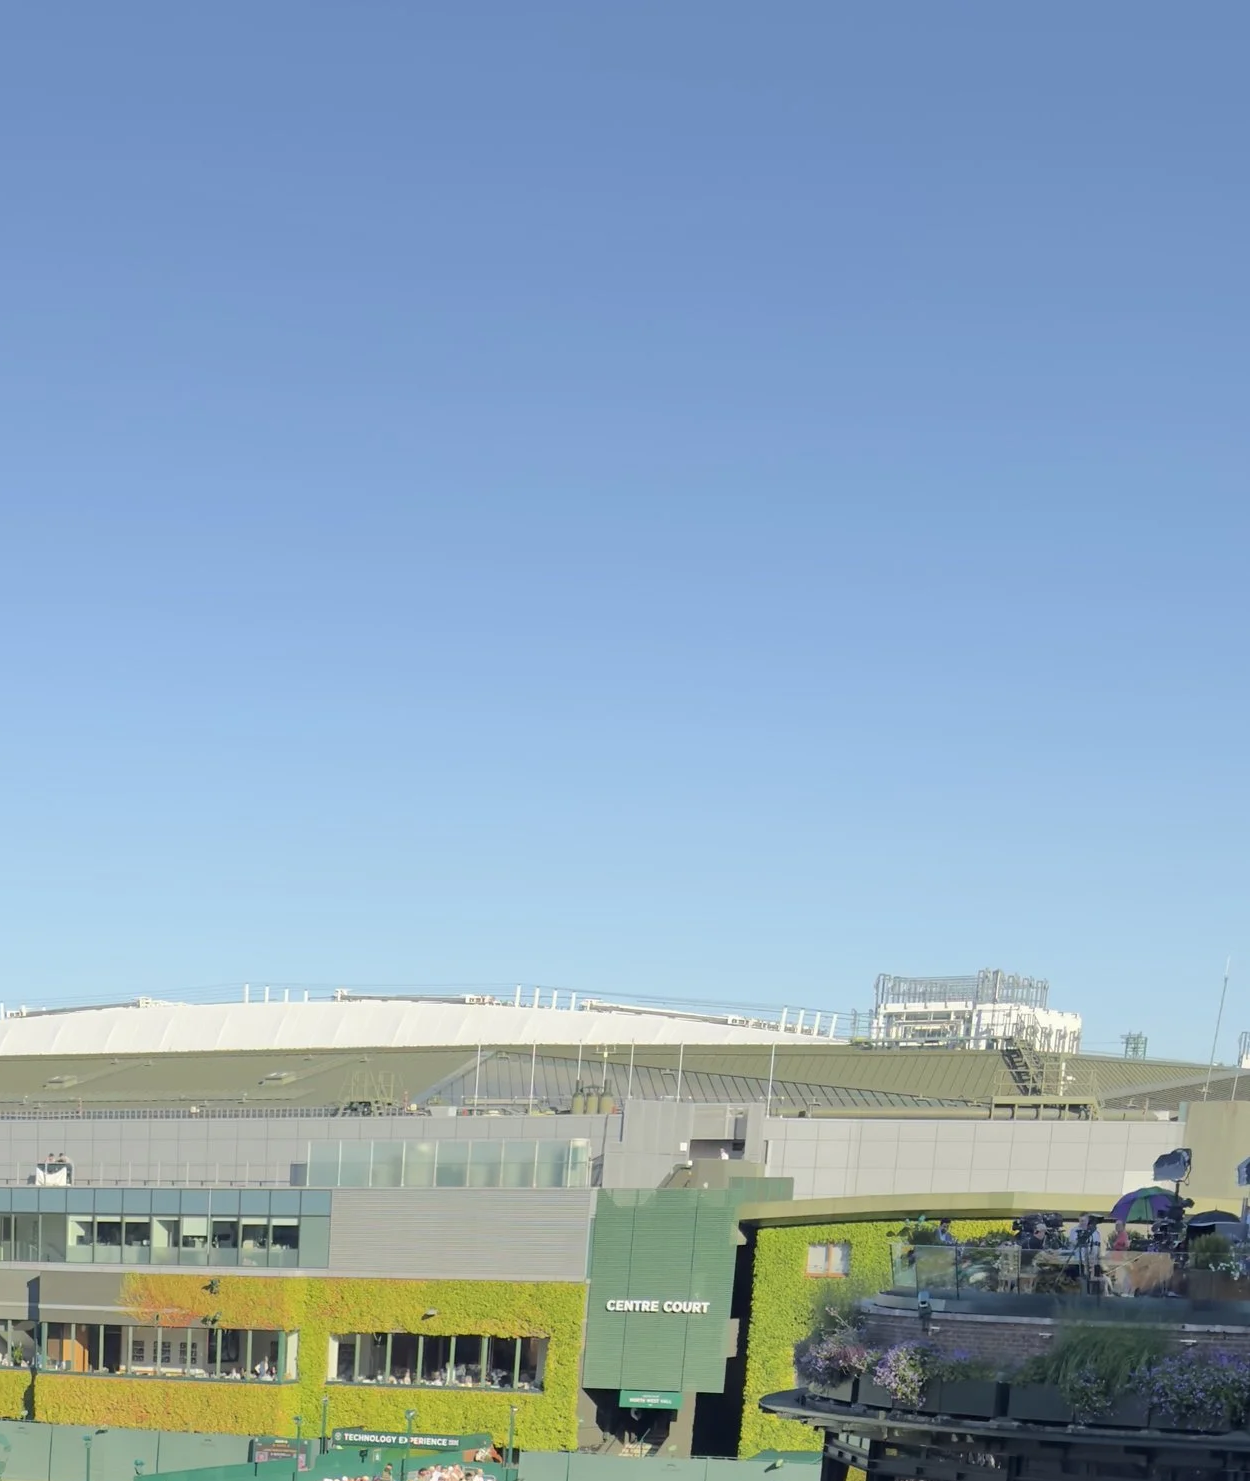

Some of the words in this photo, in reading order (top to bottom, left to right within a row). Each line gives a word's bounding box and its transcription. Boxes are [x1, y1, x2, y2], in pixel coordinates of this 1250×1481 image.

[606, 1300, 659, 1313] CENTRE
[663, 1301, 710, 1314] COURT
[344, 1433, 397, 1444] TECHNOLOGY
